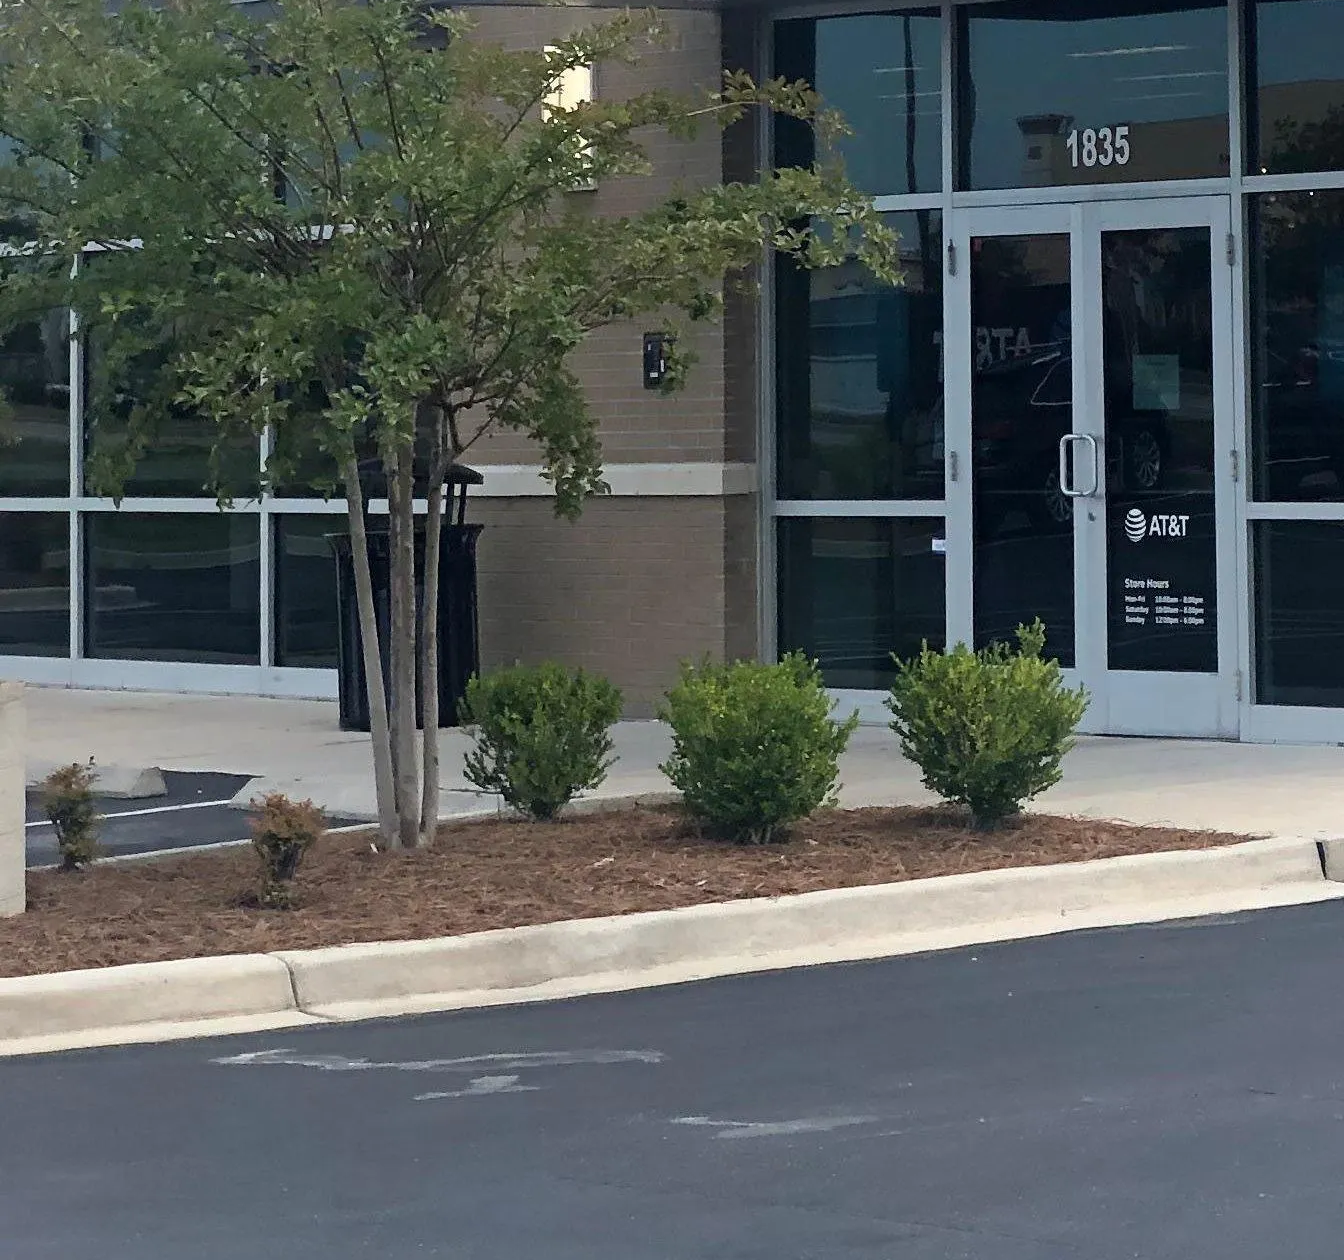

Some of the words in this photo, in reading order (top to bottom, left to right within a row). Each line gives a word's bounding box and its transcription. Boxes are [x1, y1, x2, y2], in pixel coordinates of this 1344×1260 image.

[1066, 126, 1130, 168] 1835
[1148, 514, 1190, 537] AT&T
[1124, 578, 1146, 589] Store
[1146, 578, 1170, 589] Hours
